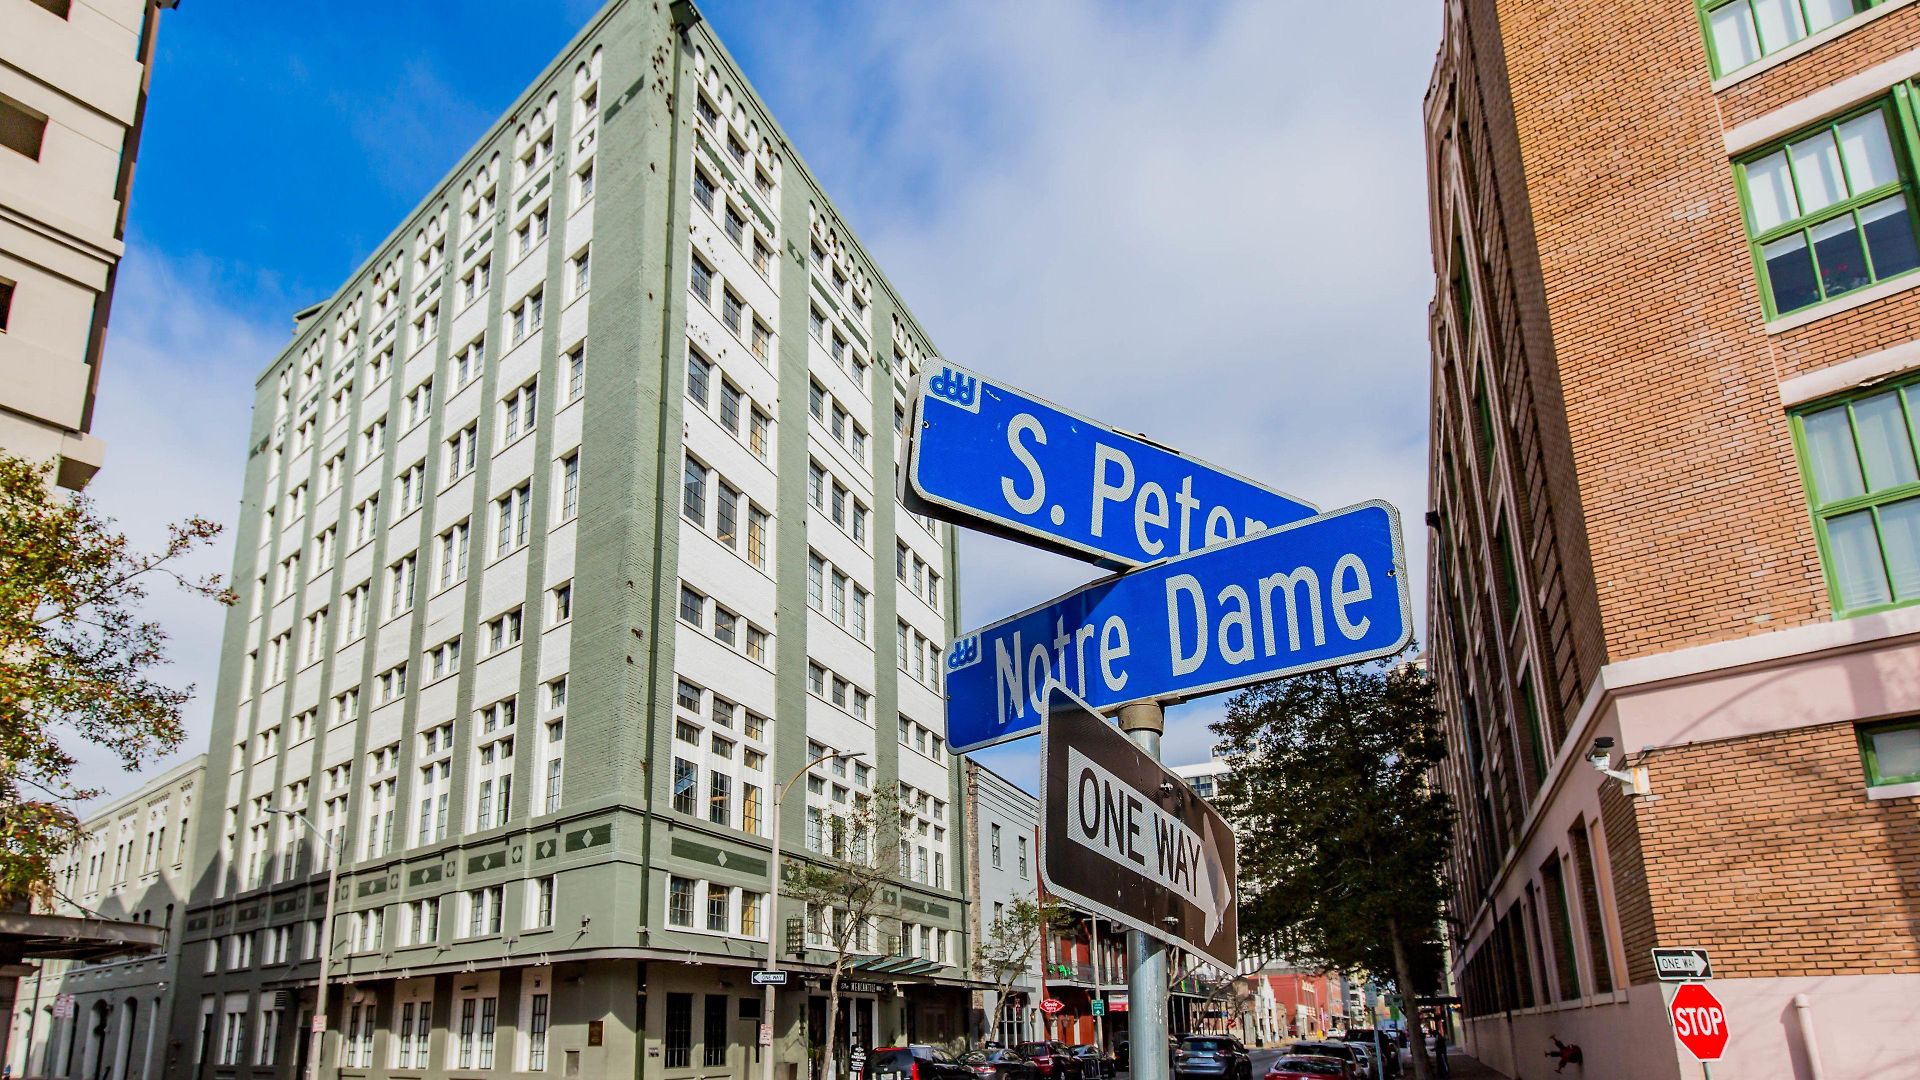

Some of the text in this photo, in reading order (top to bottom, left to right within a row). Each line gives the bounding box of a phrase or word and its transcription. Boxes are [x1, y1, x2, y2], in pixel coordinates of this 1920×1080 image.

[1001, 412, 1066, 526] S.
[995, 553, 1373, 725] Notre Dame
[1078, 767, 1202, 898] ONE WAY
[1661, 958, 1697, 969] ONE WAY
[1675, 1006, 1723, 1037] STOP
